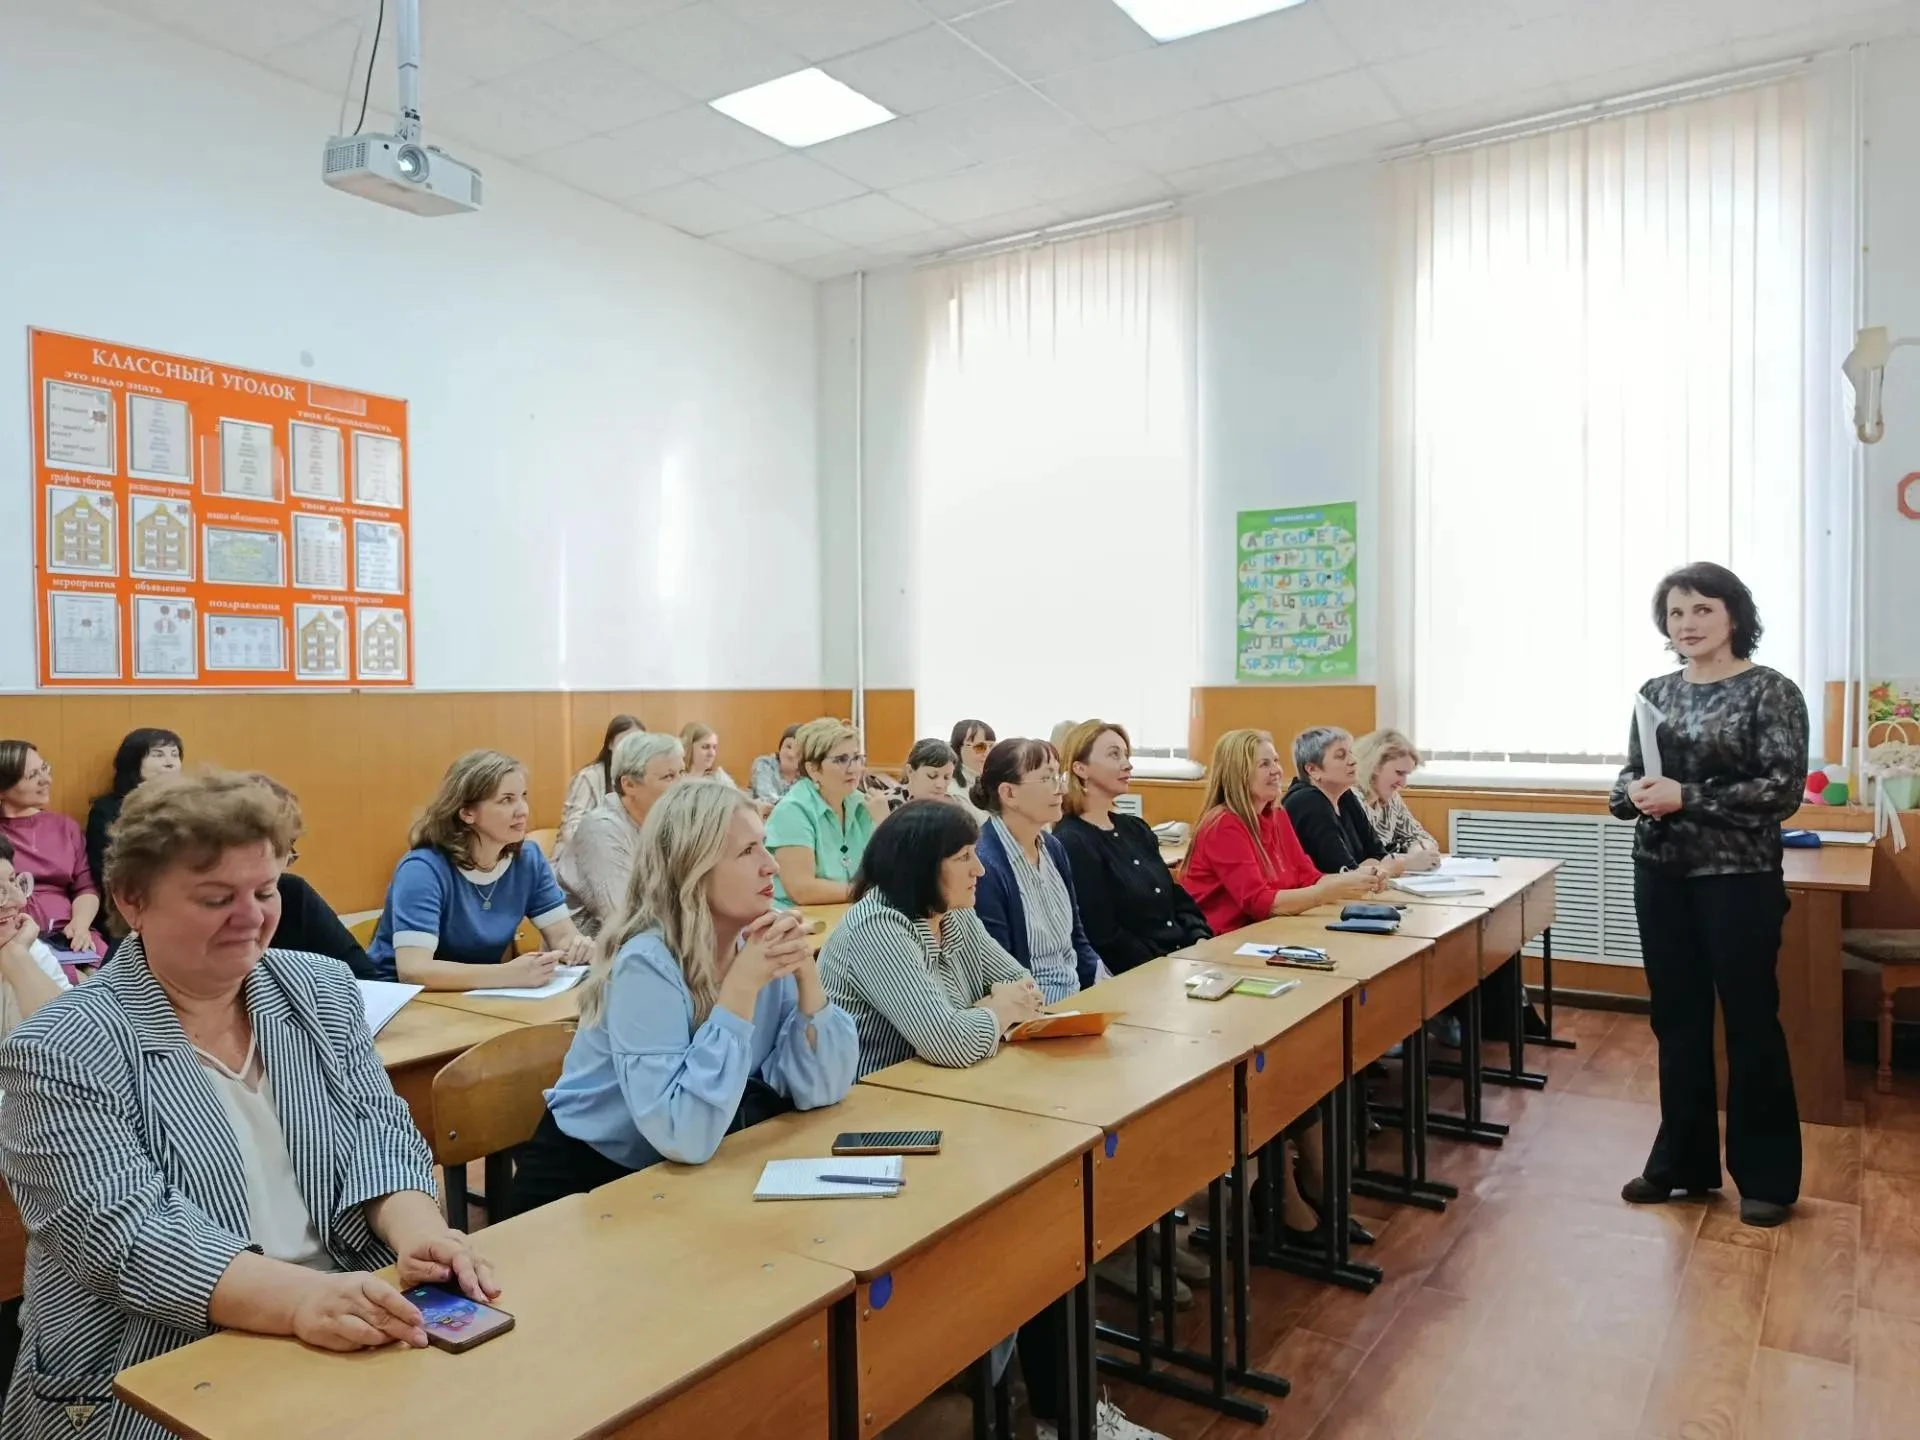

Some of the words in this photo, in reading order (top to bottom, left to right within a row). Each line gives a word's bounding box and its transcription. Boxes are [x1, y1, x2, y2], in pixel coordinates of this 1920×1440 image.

[64, 371, 88, 383] это
[91, 376, 124, 388] надо
[126, 382, 163, 394] знать
[91, 348, 214, 386] КЛАССНЫЙ
[221, 373, 297, 401] УГОЛОК
[52, 578, 116, 590] мероприятия
